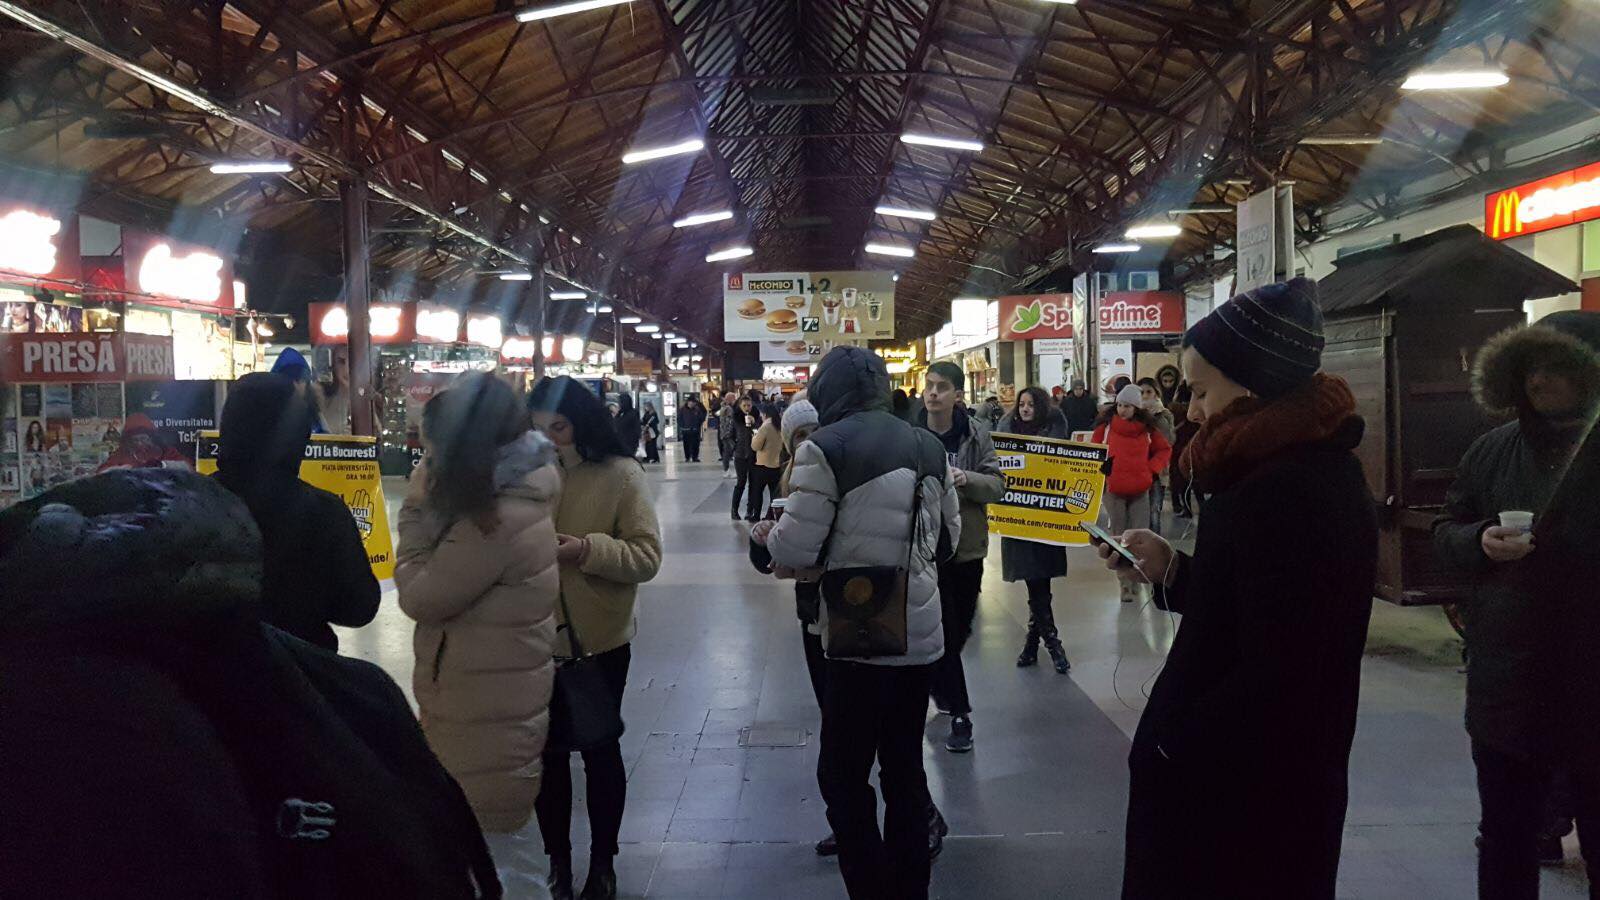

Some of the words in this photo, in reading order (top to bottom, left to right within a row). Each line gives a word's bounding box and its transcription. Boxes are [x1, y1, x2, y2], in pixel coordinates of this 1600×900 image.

[1041, 301, 1160, 330] Spgtime
[166, 418, 213, 428] Diversitatea
[304, 446, 322, 459] OȚI
[324, 445, 332, 457] la
[993, 440, 1017, 450] uarie
[1047, 446, 1055, 454] la
[1046, 478, 1067, 491] NU
[1000, 491, 1064, 509] ORUPȚIEI!
